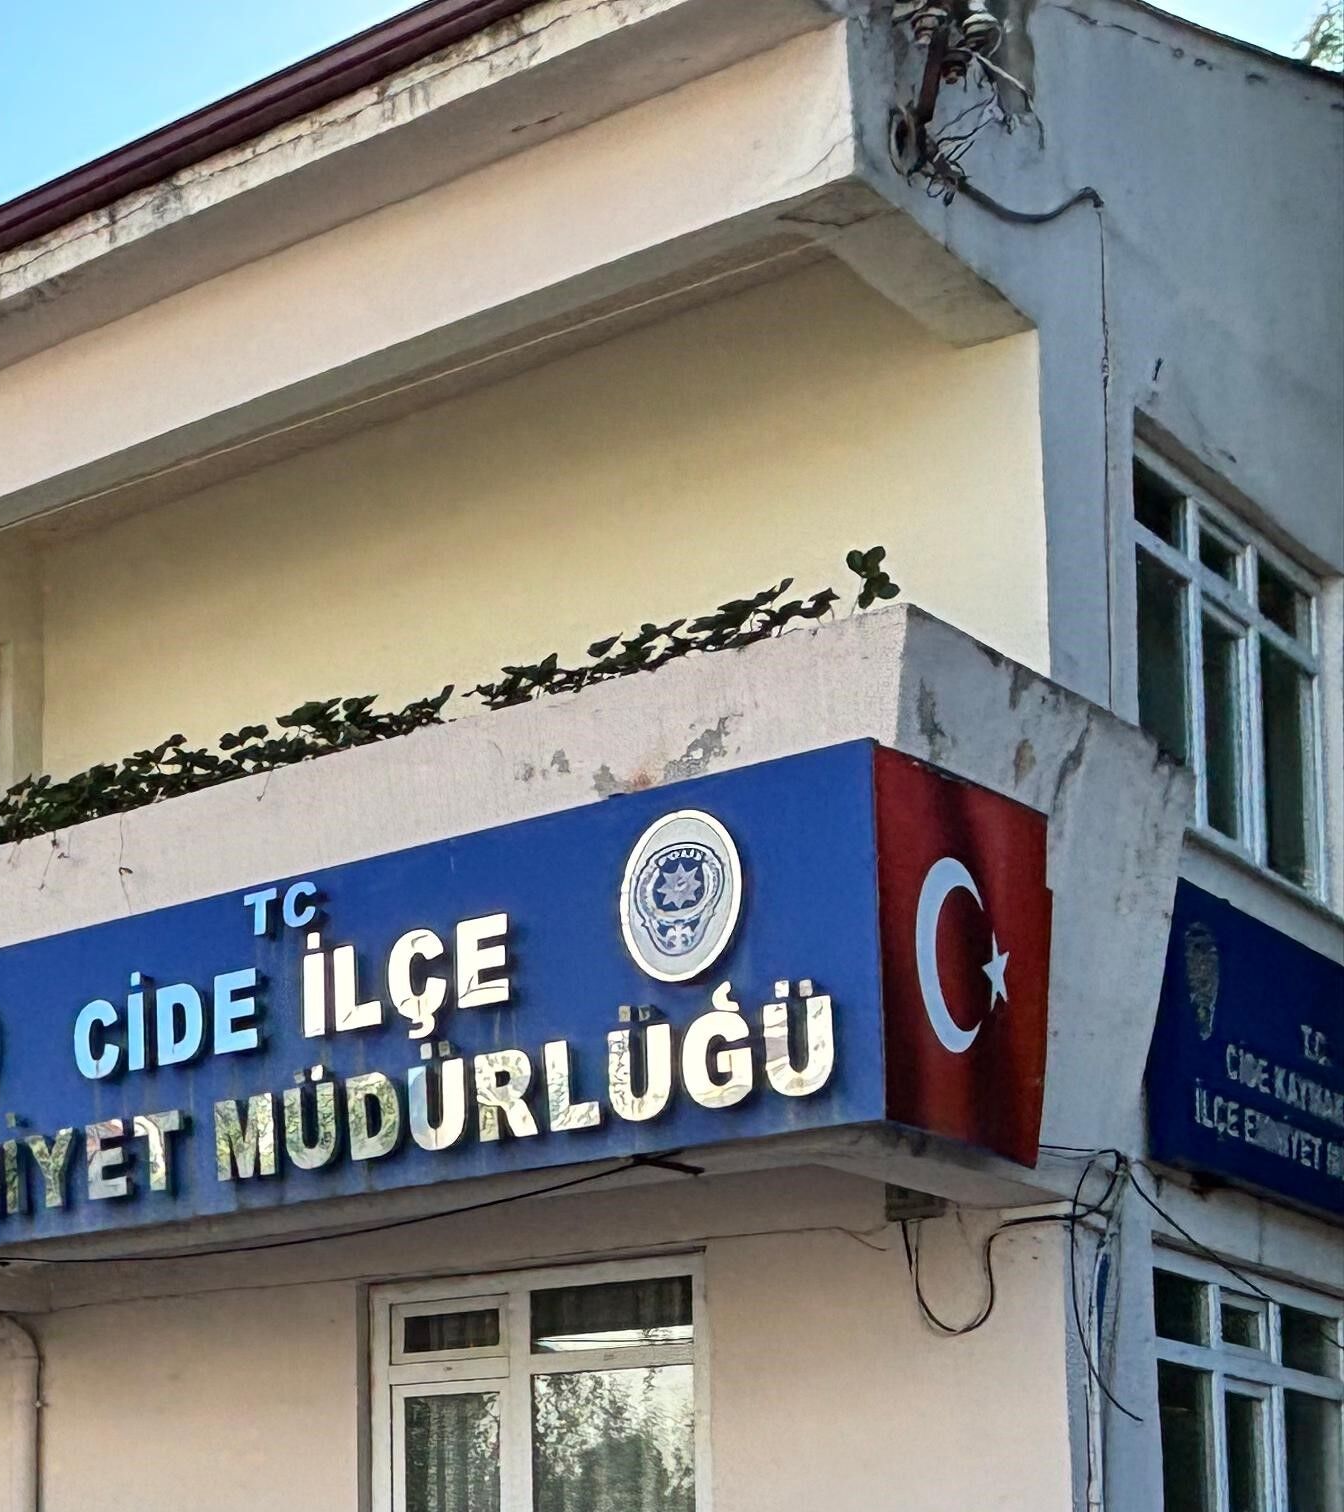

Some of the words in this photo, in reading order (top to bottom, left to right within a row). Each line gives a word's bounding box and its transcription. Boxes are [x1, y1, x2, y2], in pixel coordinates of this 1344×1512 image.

[74, 970, 259, 1080] CİDE
[302, 911, 510, 1039] İLÇE
[214, 979, 835, 1182] MÜDÜRLÜĞÜ
